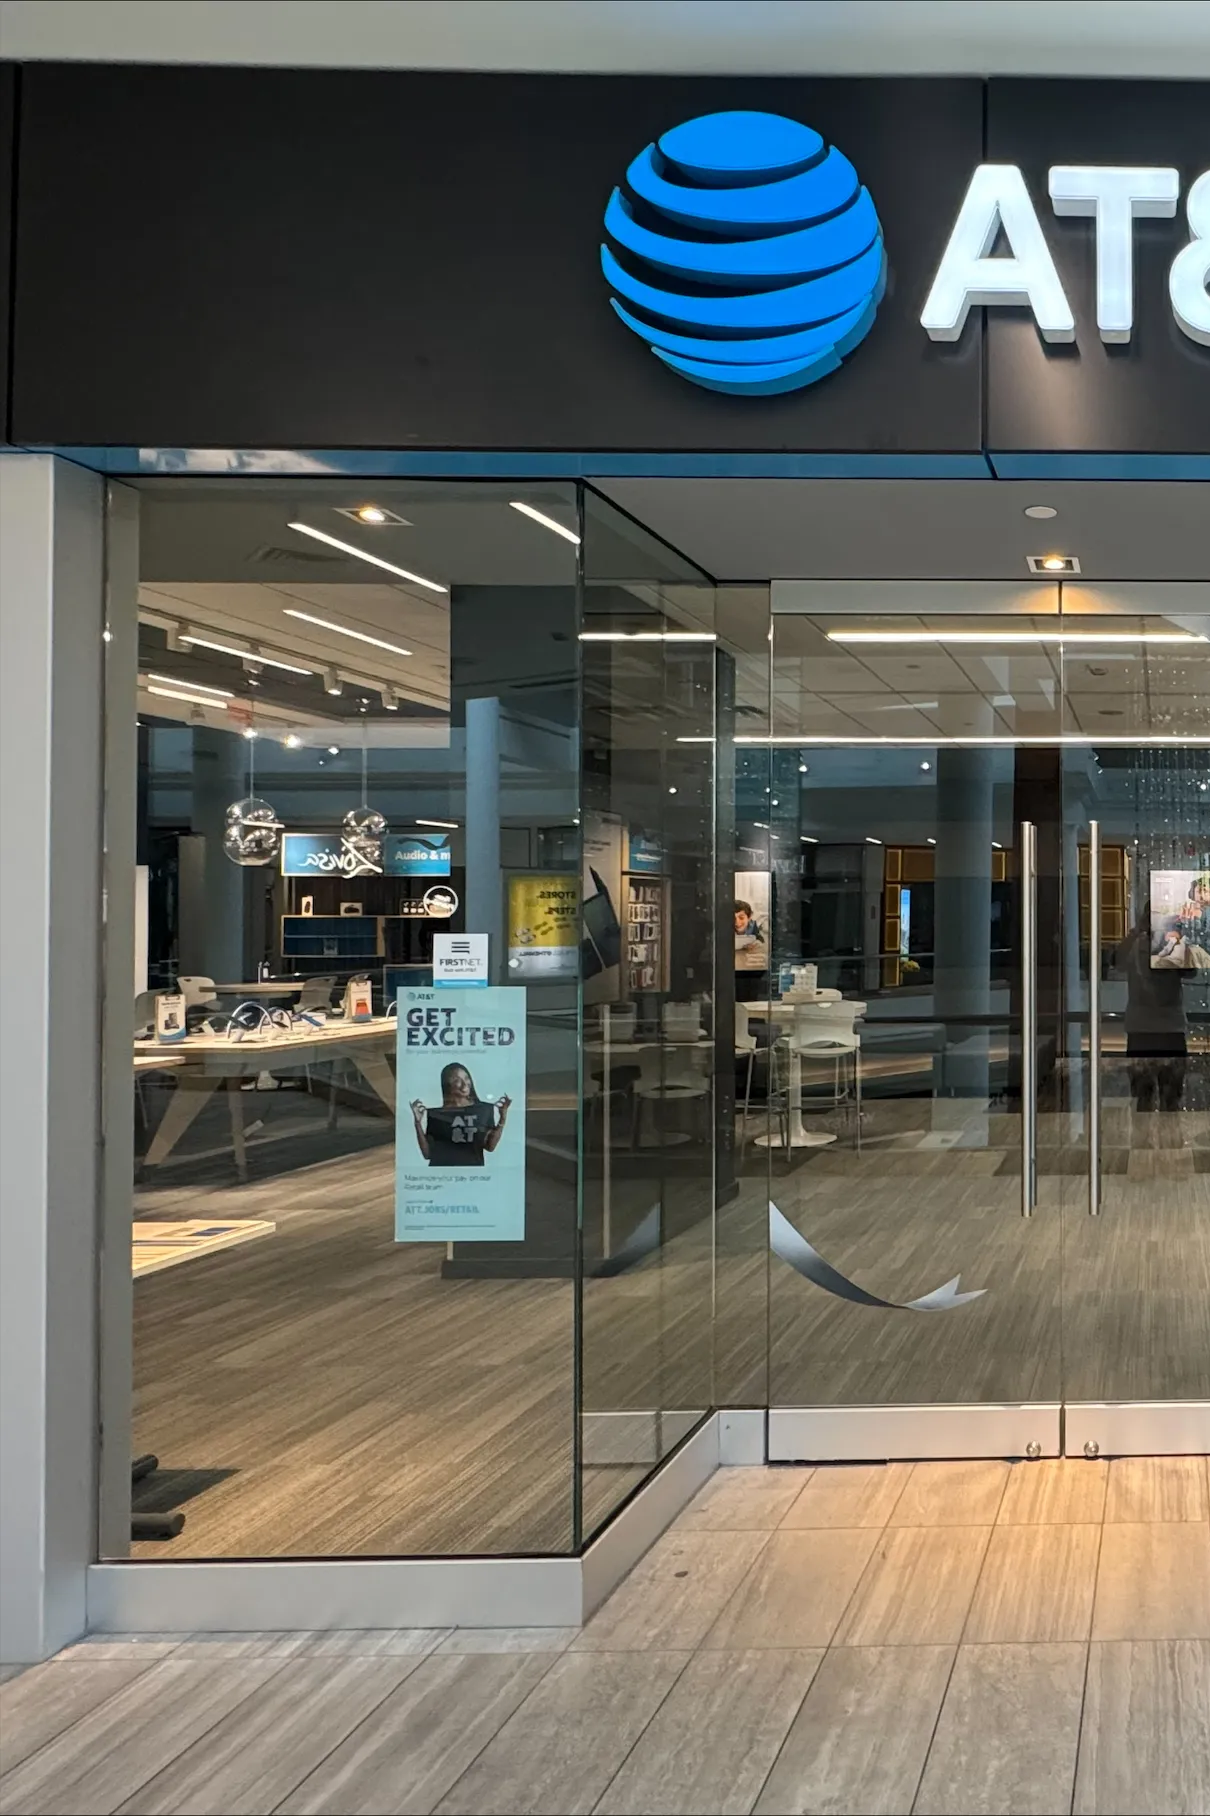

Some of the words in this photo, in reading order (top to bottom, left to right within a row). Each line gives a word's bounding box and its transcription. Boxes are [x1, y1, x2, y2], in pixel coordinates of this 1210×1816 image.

[395, 850, 427, 860] Audio
[428, 850, 439, 860] &
[406, 1007, 457, 1027] GET
[406, 1027, 516, 1047] EXCITED
[451, 1114, 478, 1128] AT
[451, 1127, 478, 1143] &T
